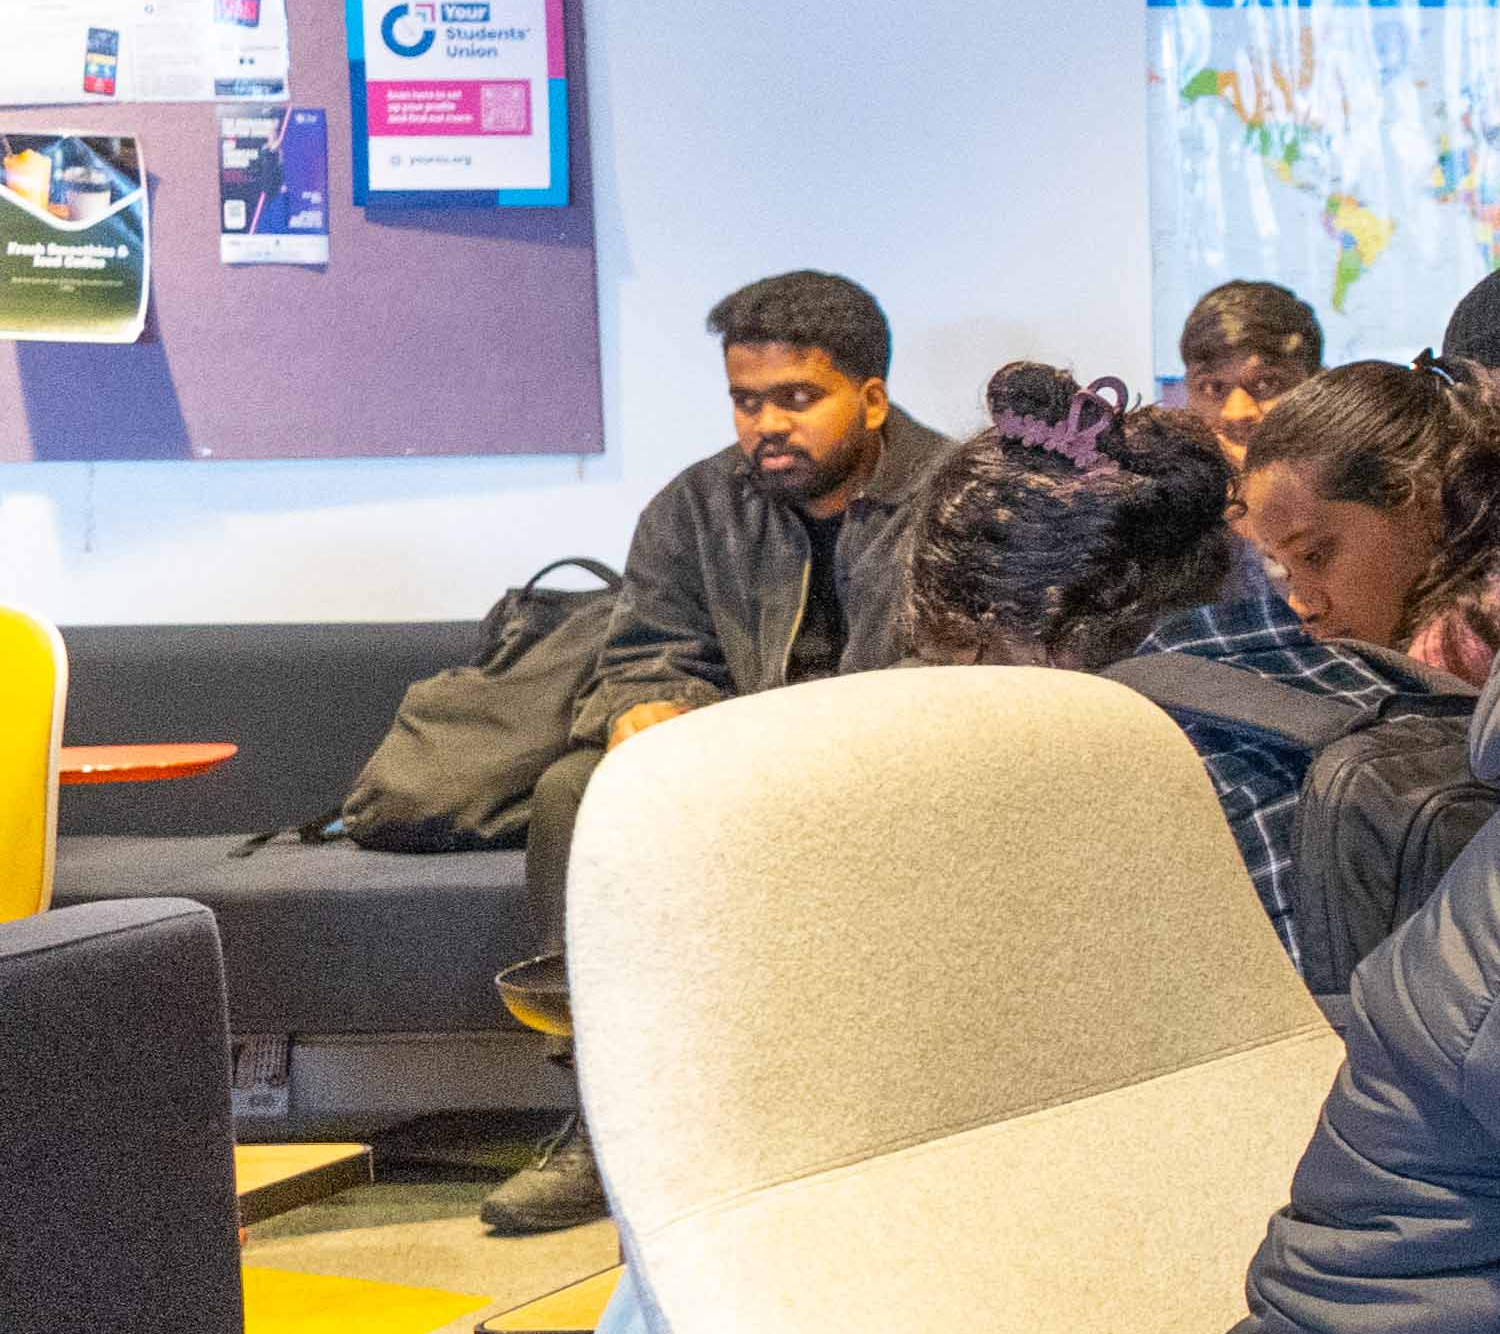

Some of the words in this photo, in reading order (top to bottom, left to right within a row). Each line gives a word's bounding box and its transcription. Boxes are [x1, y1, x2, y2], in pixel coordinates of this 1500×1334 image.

[445, 4, 488, 20] Your
[445, 26, 531, 42] Students'
[446, 42, 498, 58] Union
